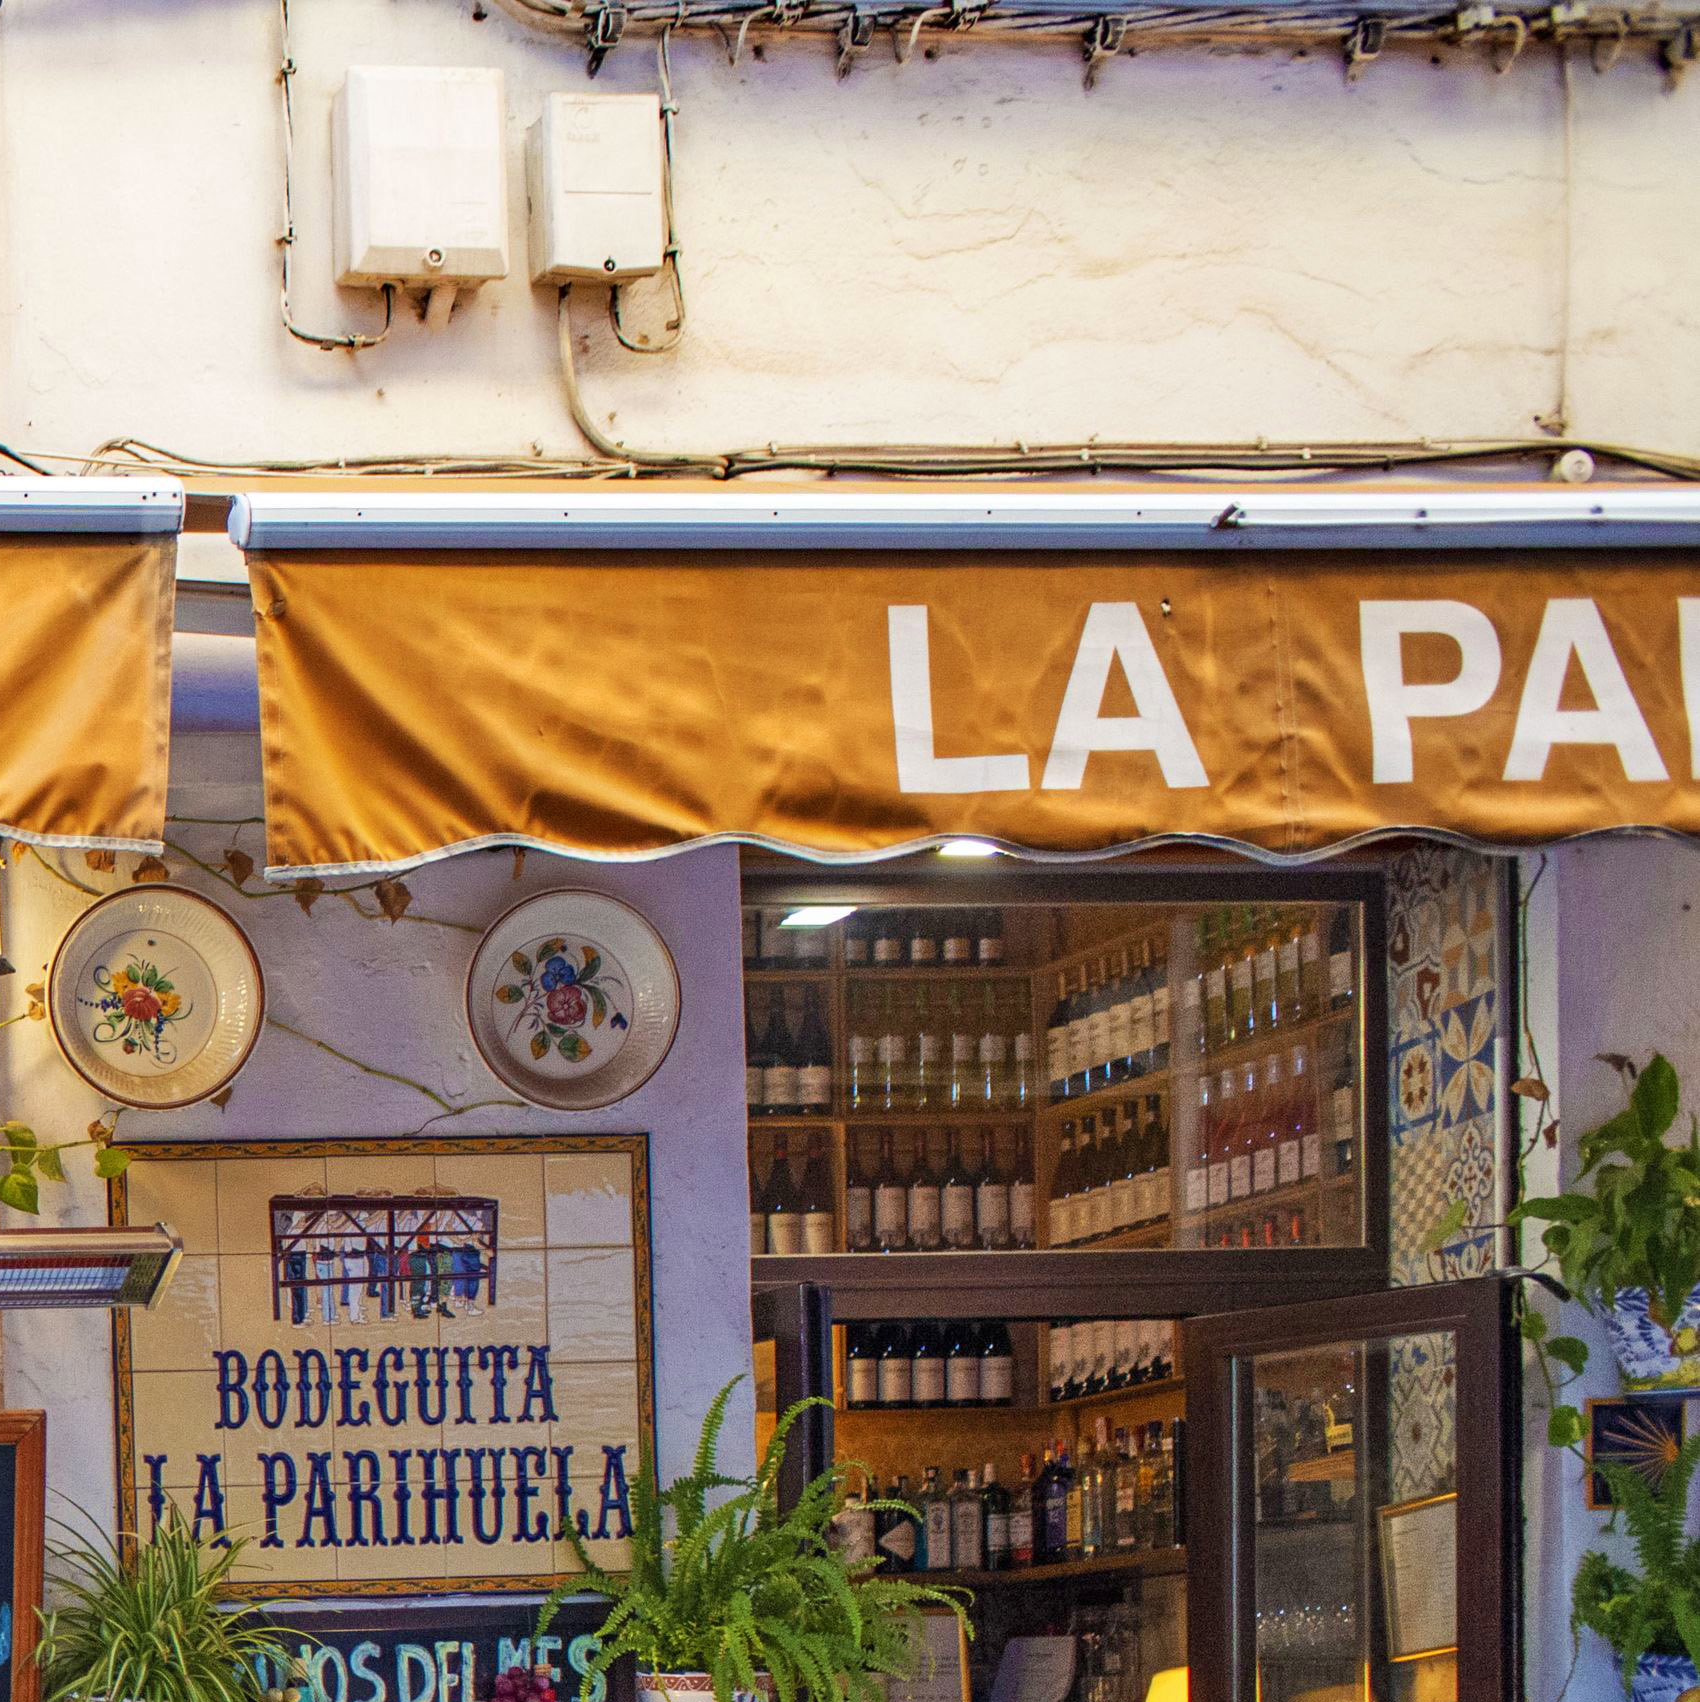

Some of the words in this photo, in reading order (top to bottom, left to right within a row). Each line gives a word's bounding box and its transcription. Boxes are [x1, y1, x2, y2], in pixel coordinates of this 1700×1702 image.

[889, 603, 1207, 793] LA
[1361, 598, 1700, 783] PA
[213, 1345, 559, 1430] BODEGUITA
[142, 1453, 231, 1549] LA
[257, 1444, 635, 1549] PARIHUELA
